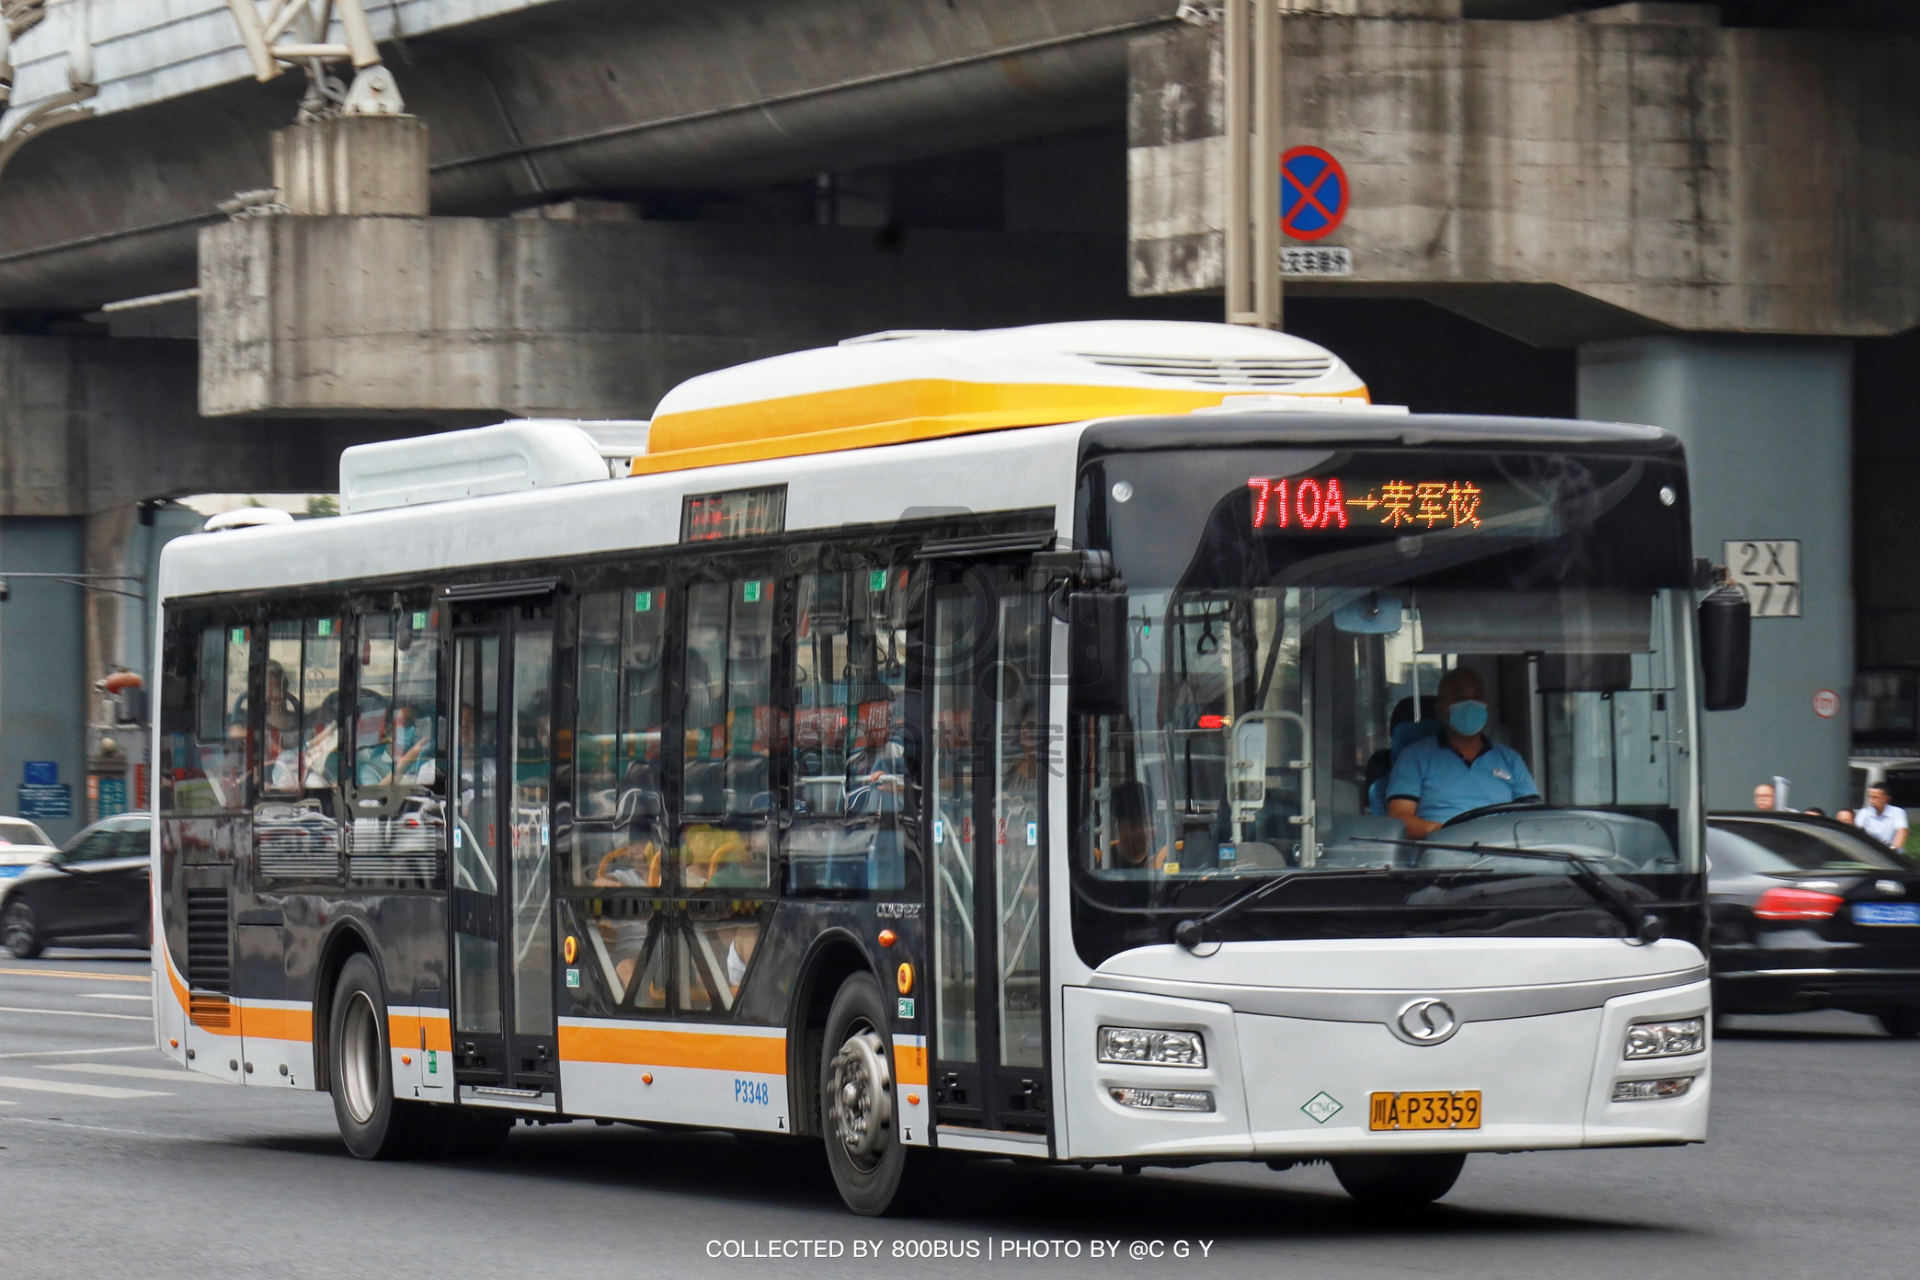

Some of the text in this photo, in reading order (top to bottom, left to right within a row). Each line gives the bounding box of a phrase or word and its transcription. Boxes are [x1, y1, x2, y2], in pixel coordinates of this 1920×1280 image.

[1248, 478, 1482, 529] 710A 荣军校
[1741, 543, 1785, 576] 2X
[735, 1078, 769, 1106] P3348
[1309, 1101, 1335, 1114] CNG
